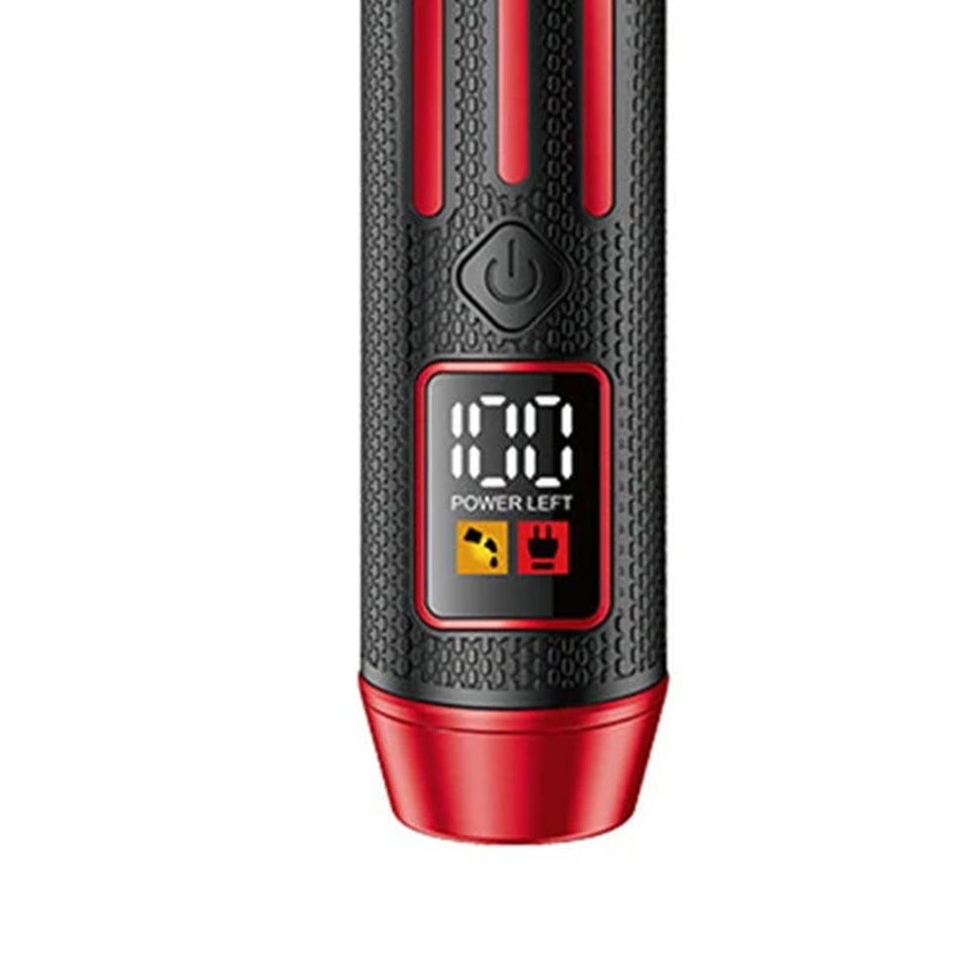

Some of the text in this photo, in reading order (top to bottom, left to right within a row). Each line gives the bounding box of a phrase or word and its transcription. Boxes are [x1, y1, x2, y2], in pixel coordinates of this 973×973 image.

[451, 395, 573, 489] 100
[451, 494, 573, 512] POWER LEFT
